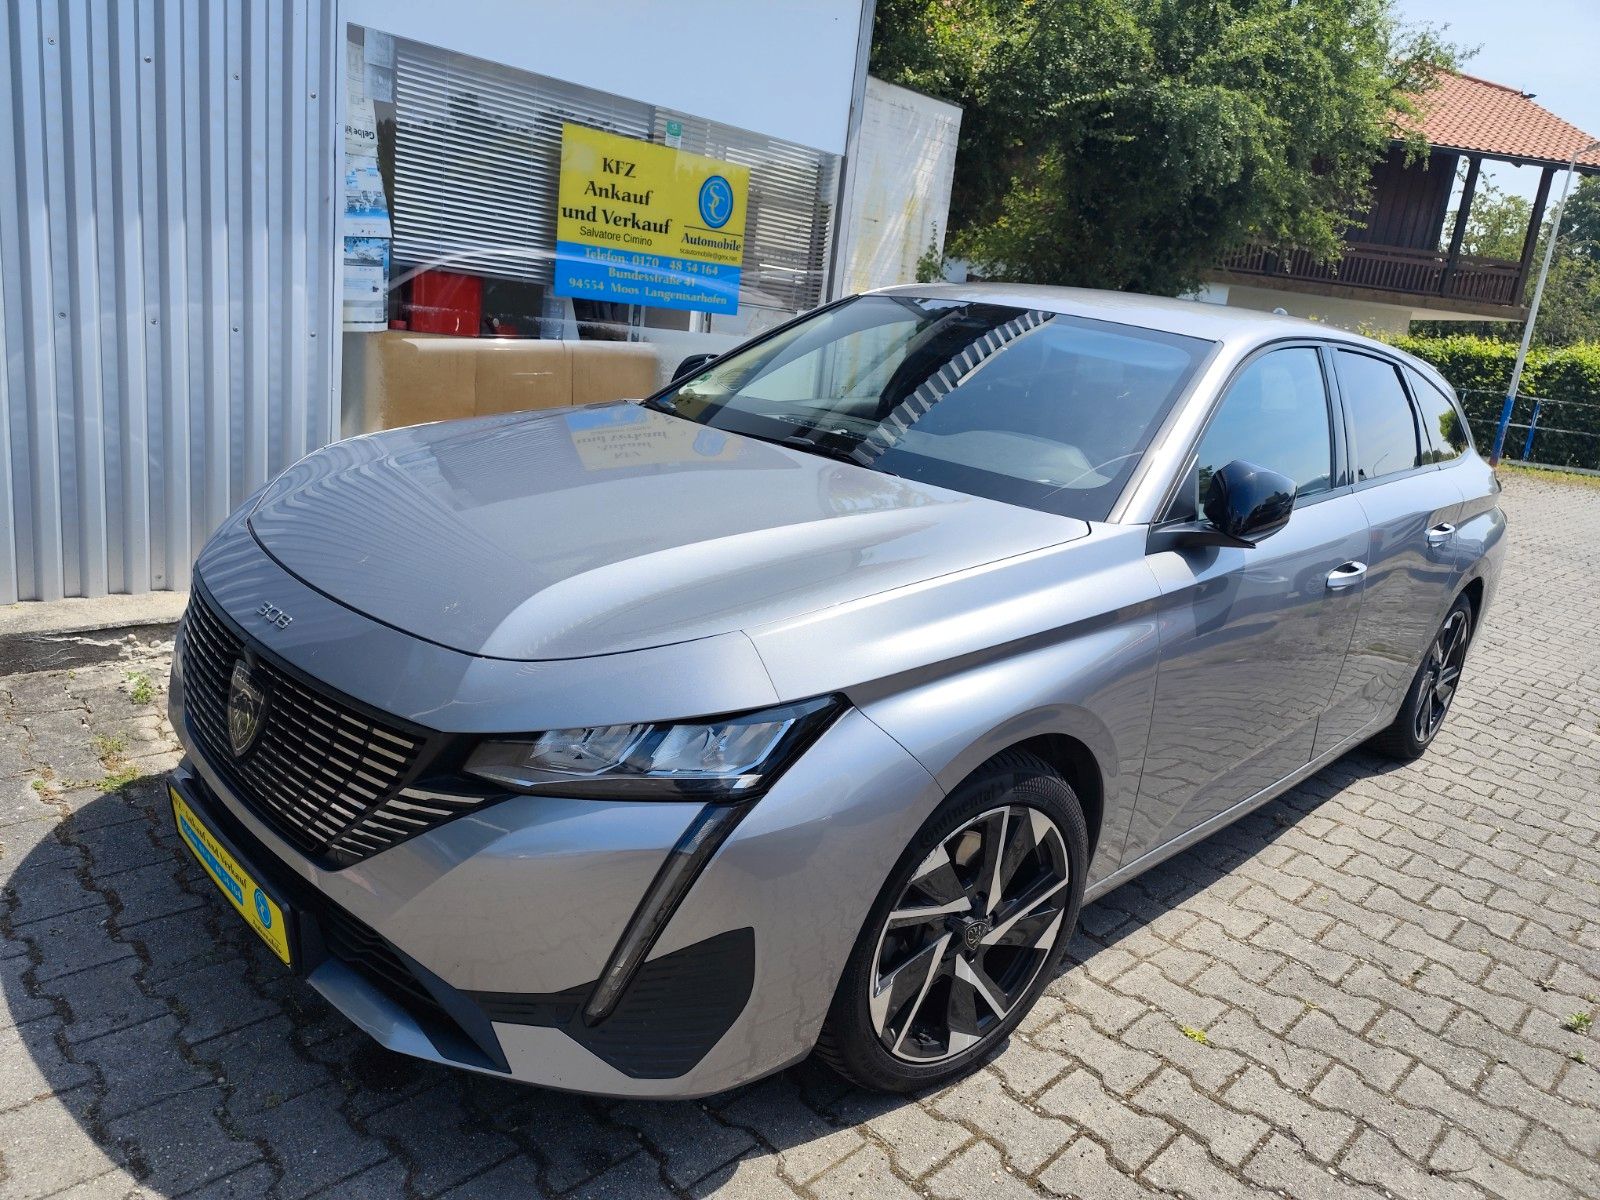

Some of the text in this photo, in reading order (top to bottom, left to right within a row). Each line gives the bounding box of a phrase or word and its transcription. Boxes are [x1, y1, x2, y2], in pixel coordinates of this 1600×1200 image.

[602, 157, 637, 179] KFZ
[584, 180, 654, 206] Ankauf
[562, 205, 673, 235] und Verkauf
[579, 226, 653, 247] Salvatore Cimino
[681, 233, 742, 251] Automobile
[608, 266, 681, 286] Bundesstraße
[632, 255, 660, 268] 0170
[669, 260, 683, 271] 48
[687, 263, 698, 273] 54
[701, 263, 719, 276] 164
[568, 277, 604, 290] 94554
[610, 282, 639, 294] Moos
[256, 600, 293, 629] 308
